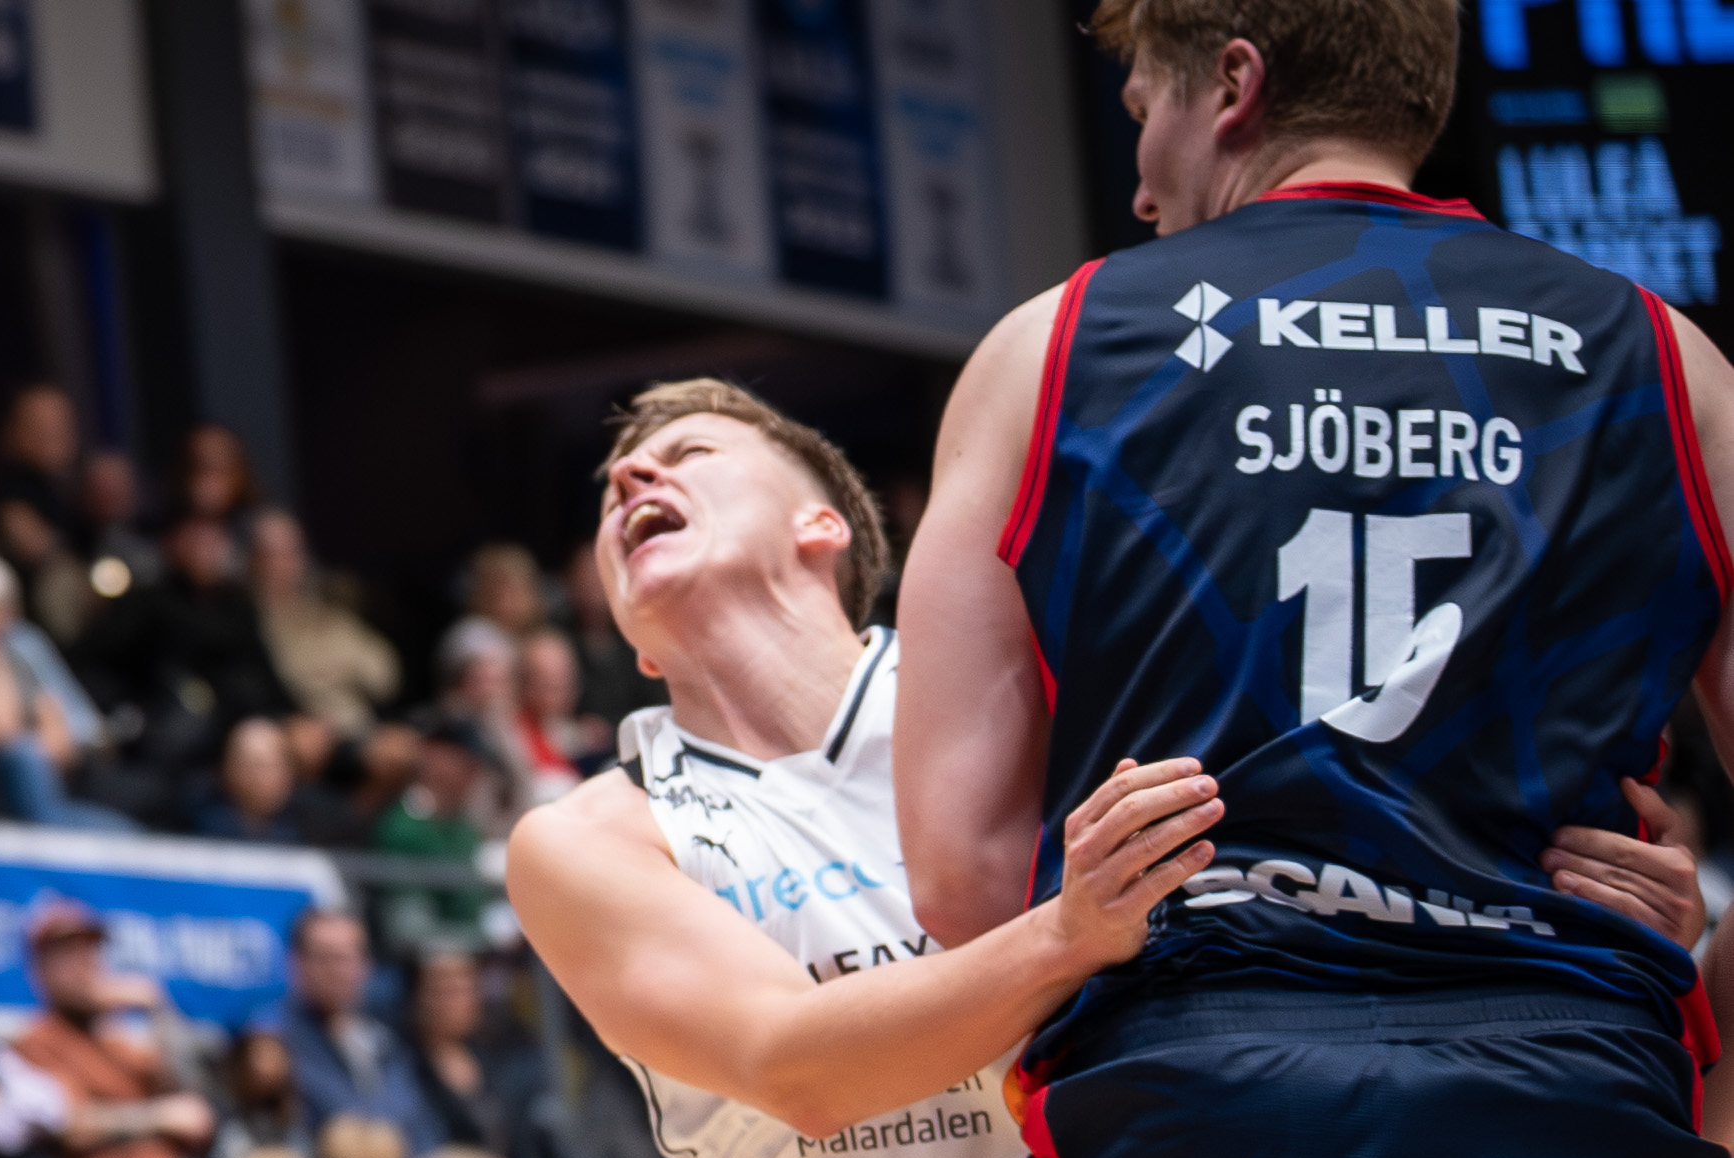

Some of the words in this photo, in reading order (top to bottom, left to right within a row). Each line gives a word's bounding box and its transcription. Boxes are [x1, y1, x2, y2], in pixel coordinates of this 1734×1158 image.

[1257, 297, 1586, 374] KELLER
[1234, 388, 1524, 485] SJÖBERG
[1277, 508, 1472, 743] 15
